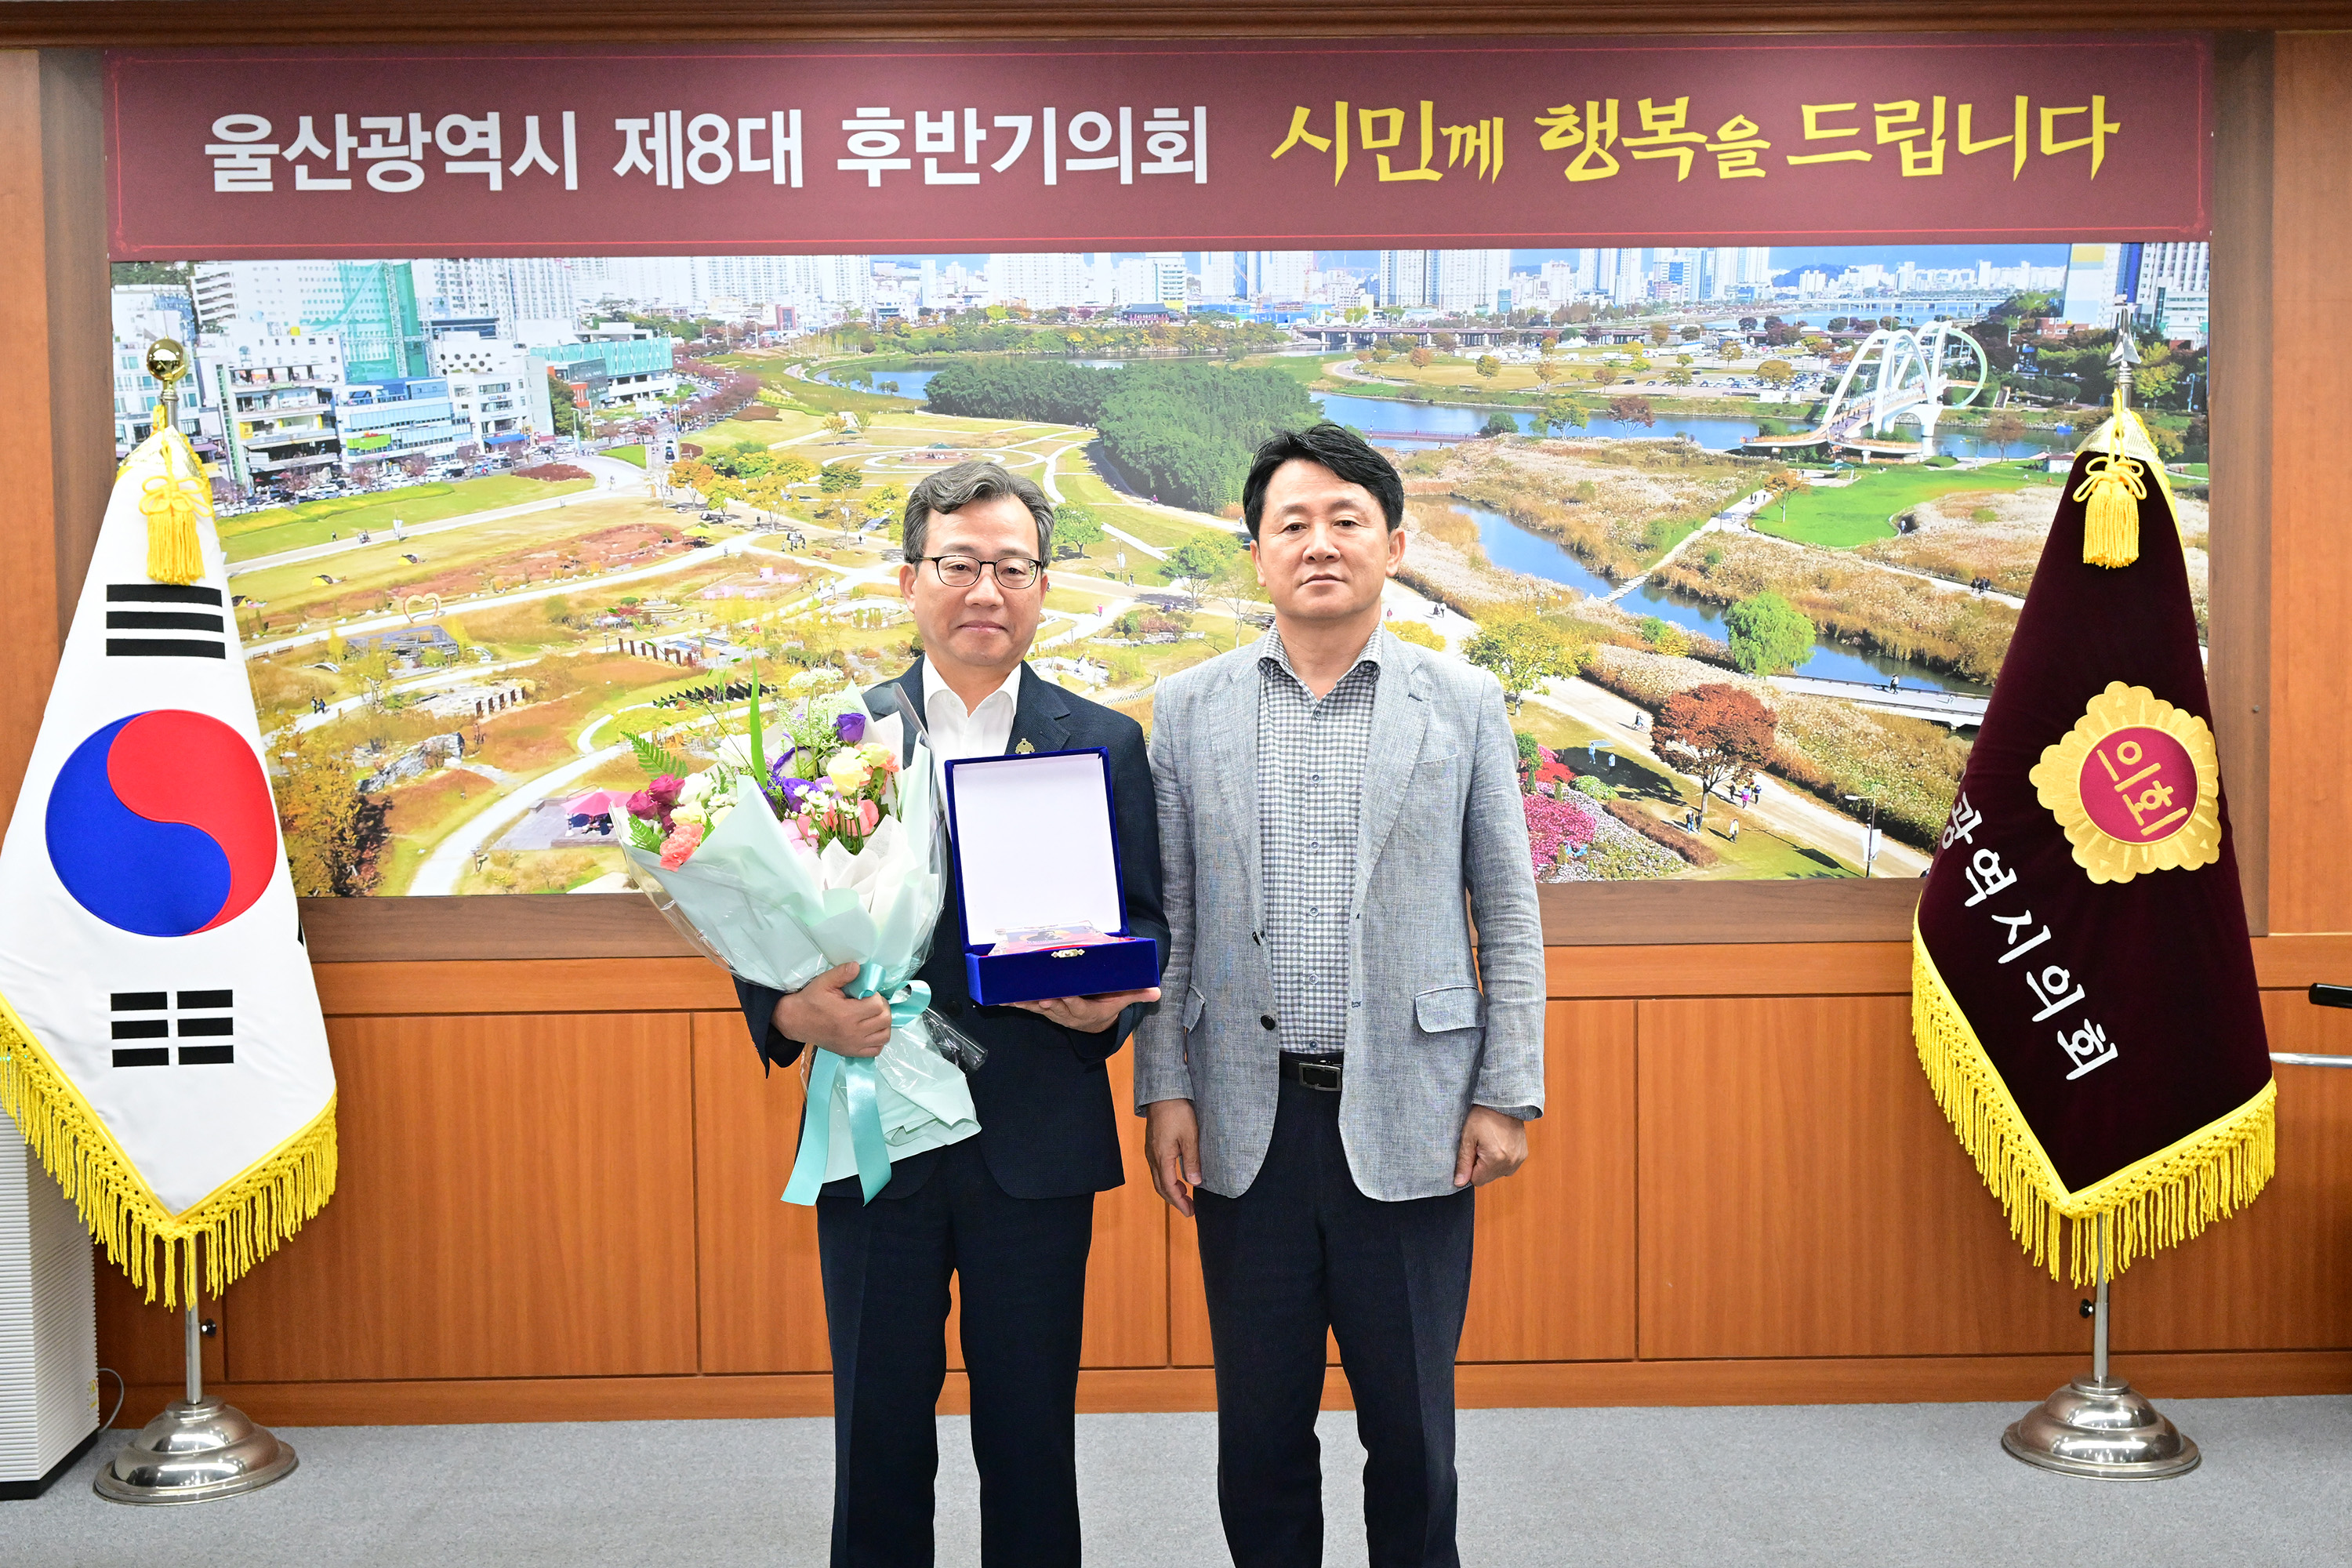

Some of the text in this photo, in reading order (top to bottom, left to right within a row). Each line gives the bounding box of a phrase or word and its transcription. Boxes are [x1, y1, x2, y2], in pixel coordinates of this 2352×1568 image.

[204, 94, 2122, 193] 울산광역시 제8대 후반기의회 시민께 행복을 드립니다
[2096, 740, 2188, 837] 의회
